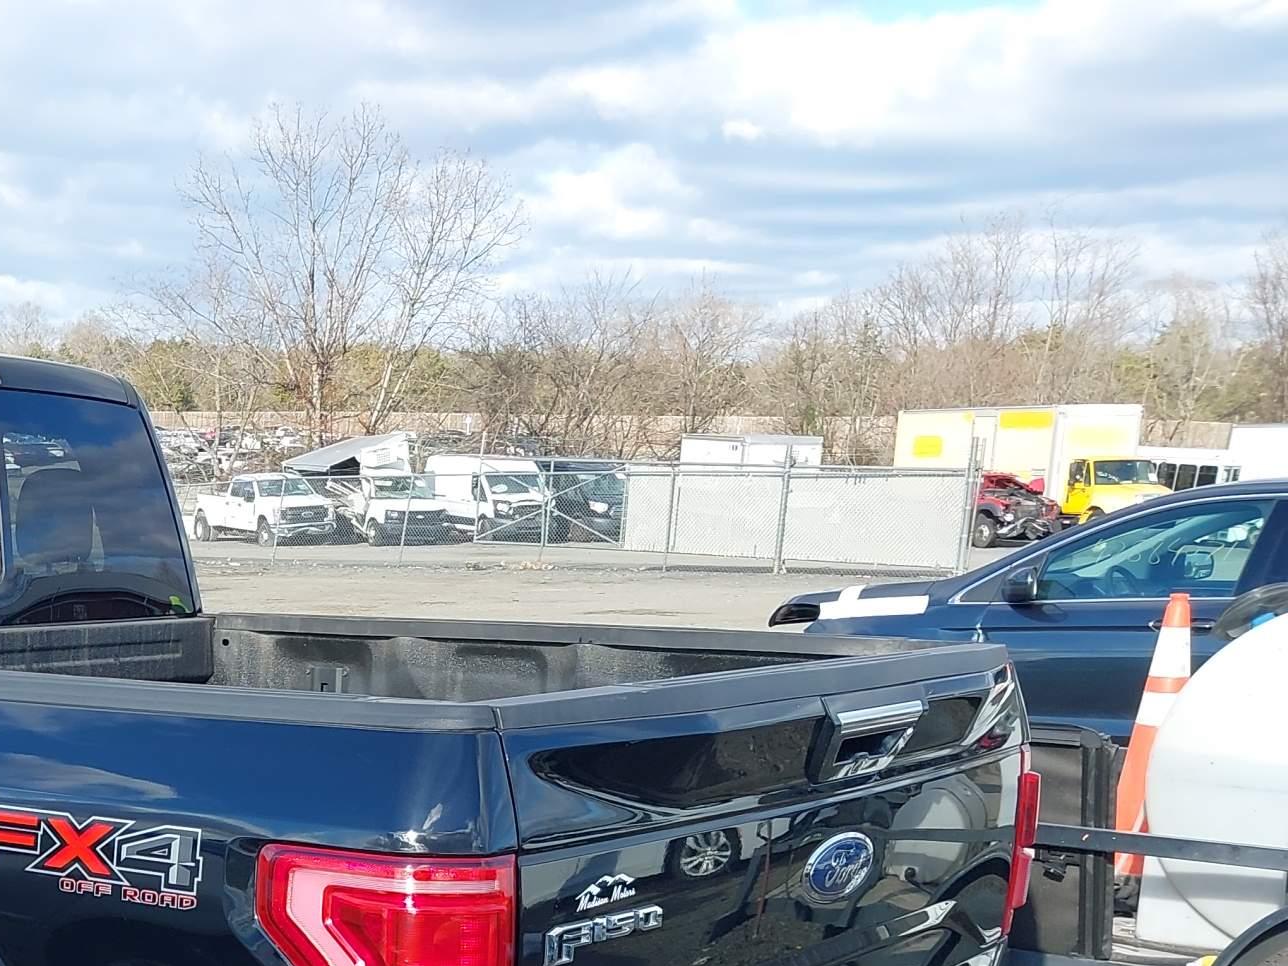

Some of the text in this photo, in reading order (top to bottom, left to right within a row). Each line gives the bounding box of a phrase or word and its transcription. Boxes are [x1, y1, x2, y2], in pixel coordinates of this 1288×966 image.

[824, 847, 872, 888] Ford
[58, 877, 198, 910] OFF ROAD
[610, 884, 637, 902] Motors
